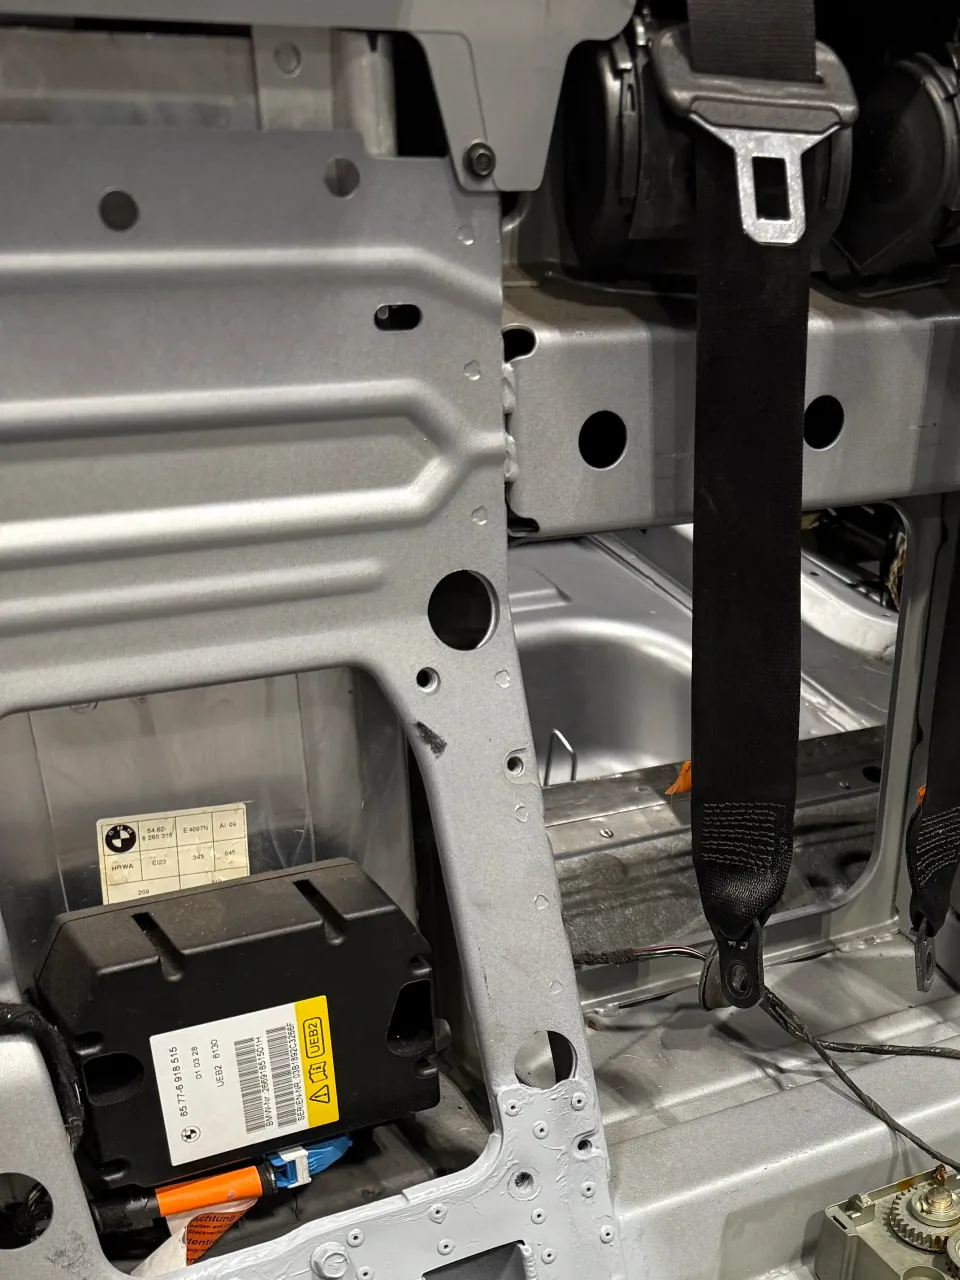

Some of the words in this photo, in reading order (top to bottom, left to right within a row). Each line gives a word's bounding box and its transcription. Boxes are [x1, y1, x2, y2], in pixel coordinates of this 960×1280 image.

[308, 1021, 320, 1054] UEB2
[169, 1046, 179, 1064] 515
[210, 1038, 221, 1059] 6130
[172, 1065, 182, 1083] 918
[214, 1064, 225, 1088] UEB2
